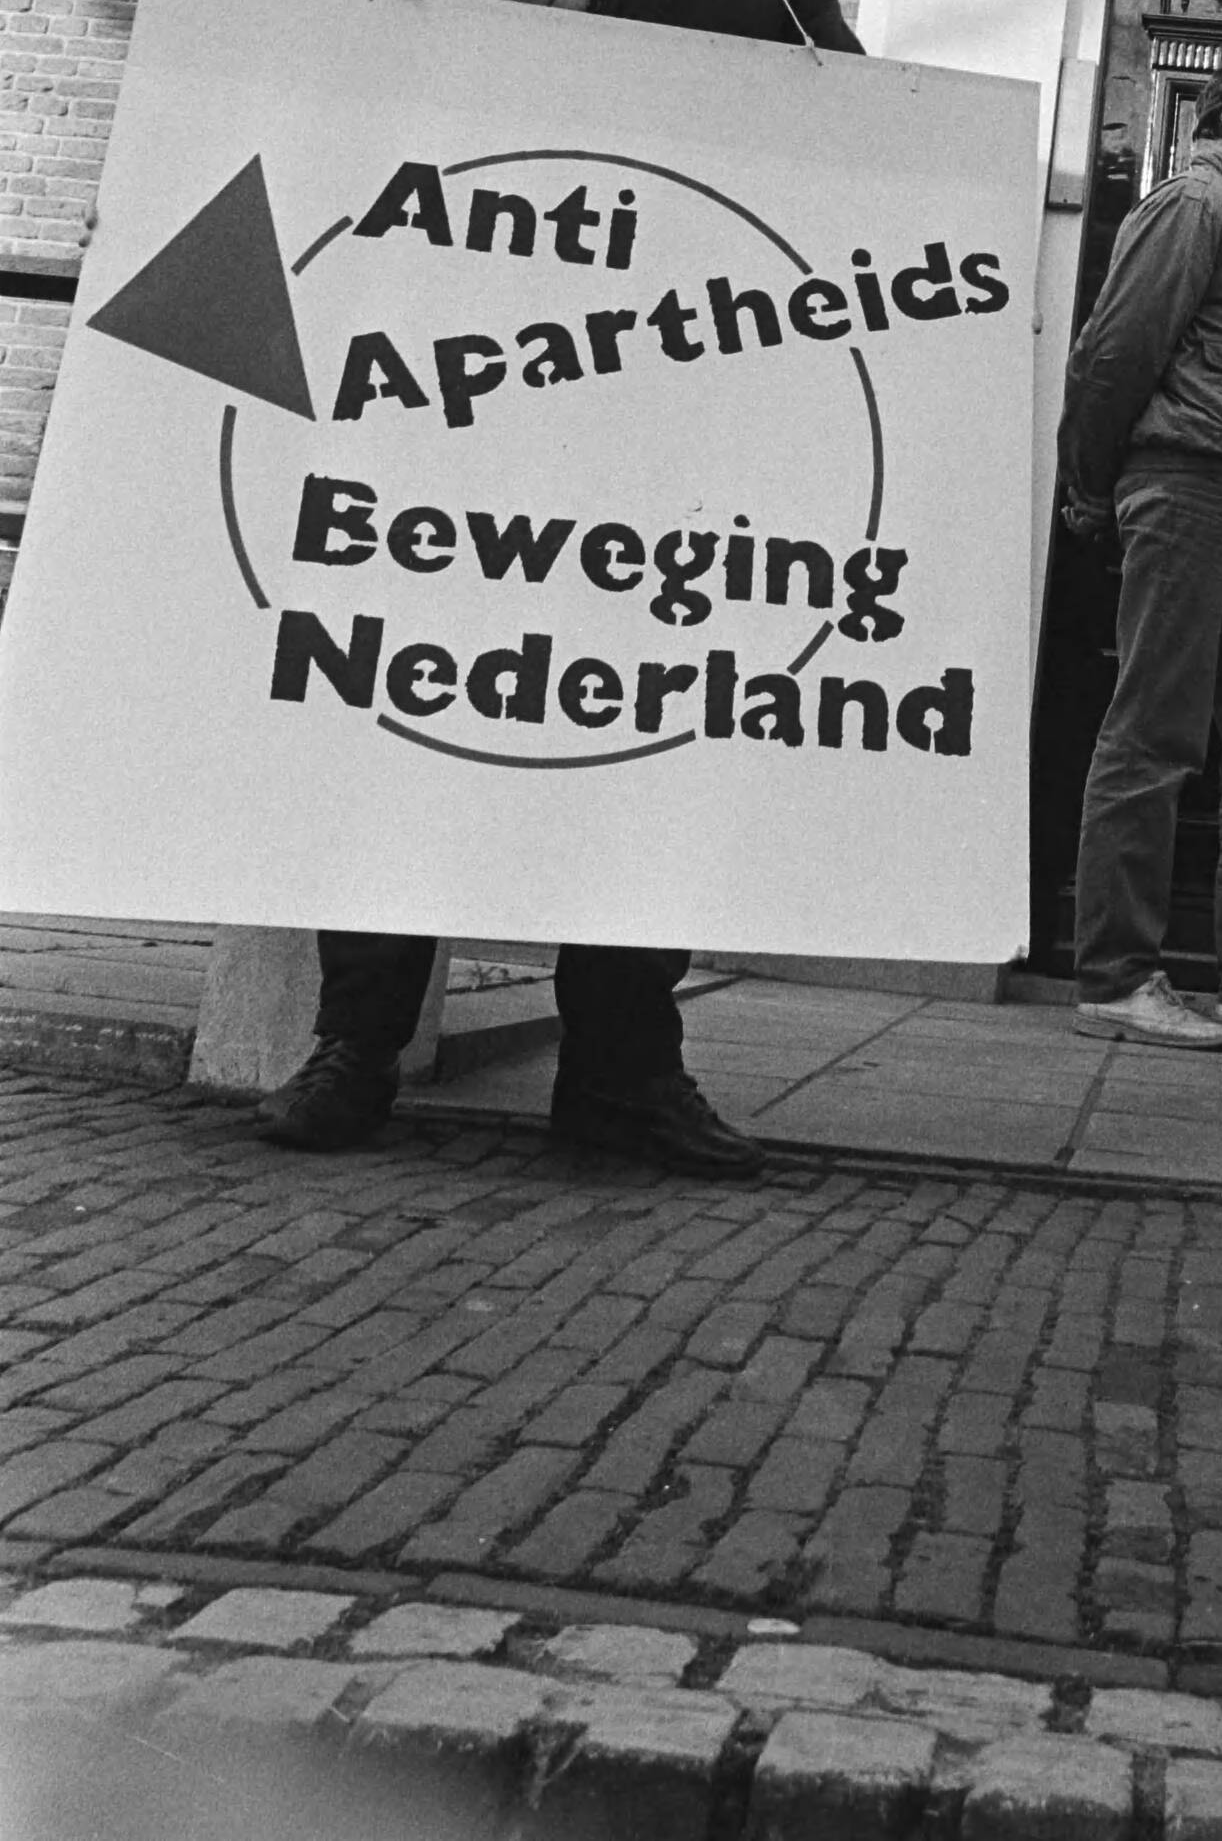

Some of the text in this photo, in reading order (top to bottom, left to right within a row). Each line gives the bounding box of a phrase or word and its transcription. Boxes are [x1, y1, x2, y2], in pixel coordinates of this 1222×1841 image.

[352, 160, 640, 271] Anti
[332, 242, 1011, 429] Apartheids
[291, 472, 908, 644] Beweging
[270, 608, 974, 757] Nederland
